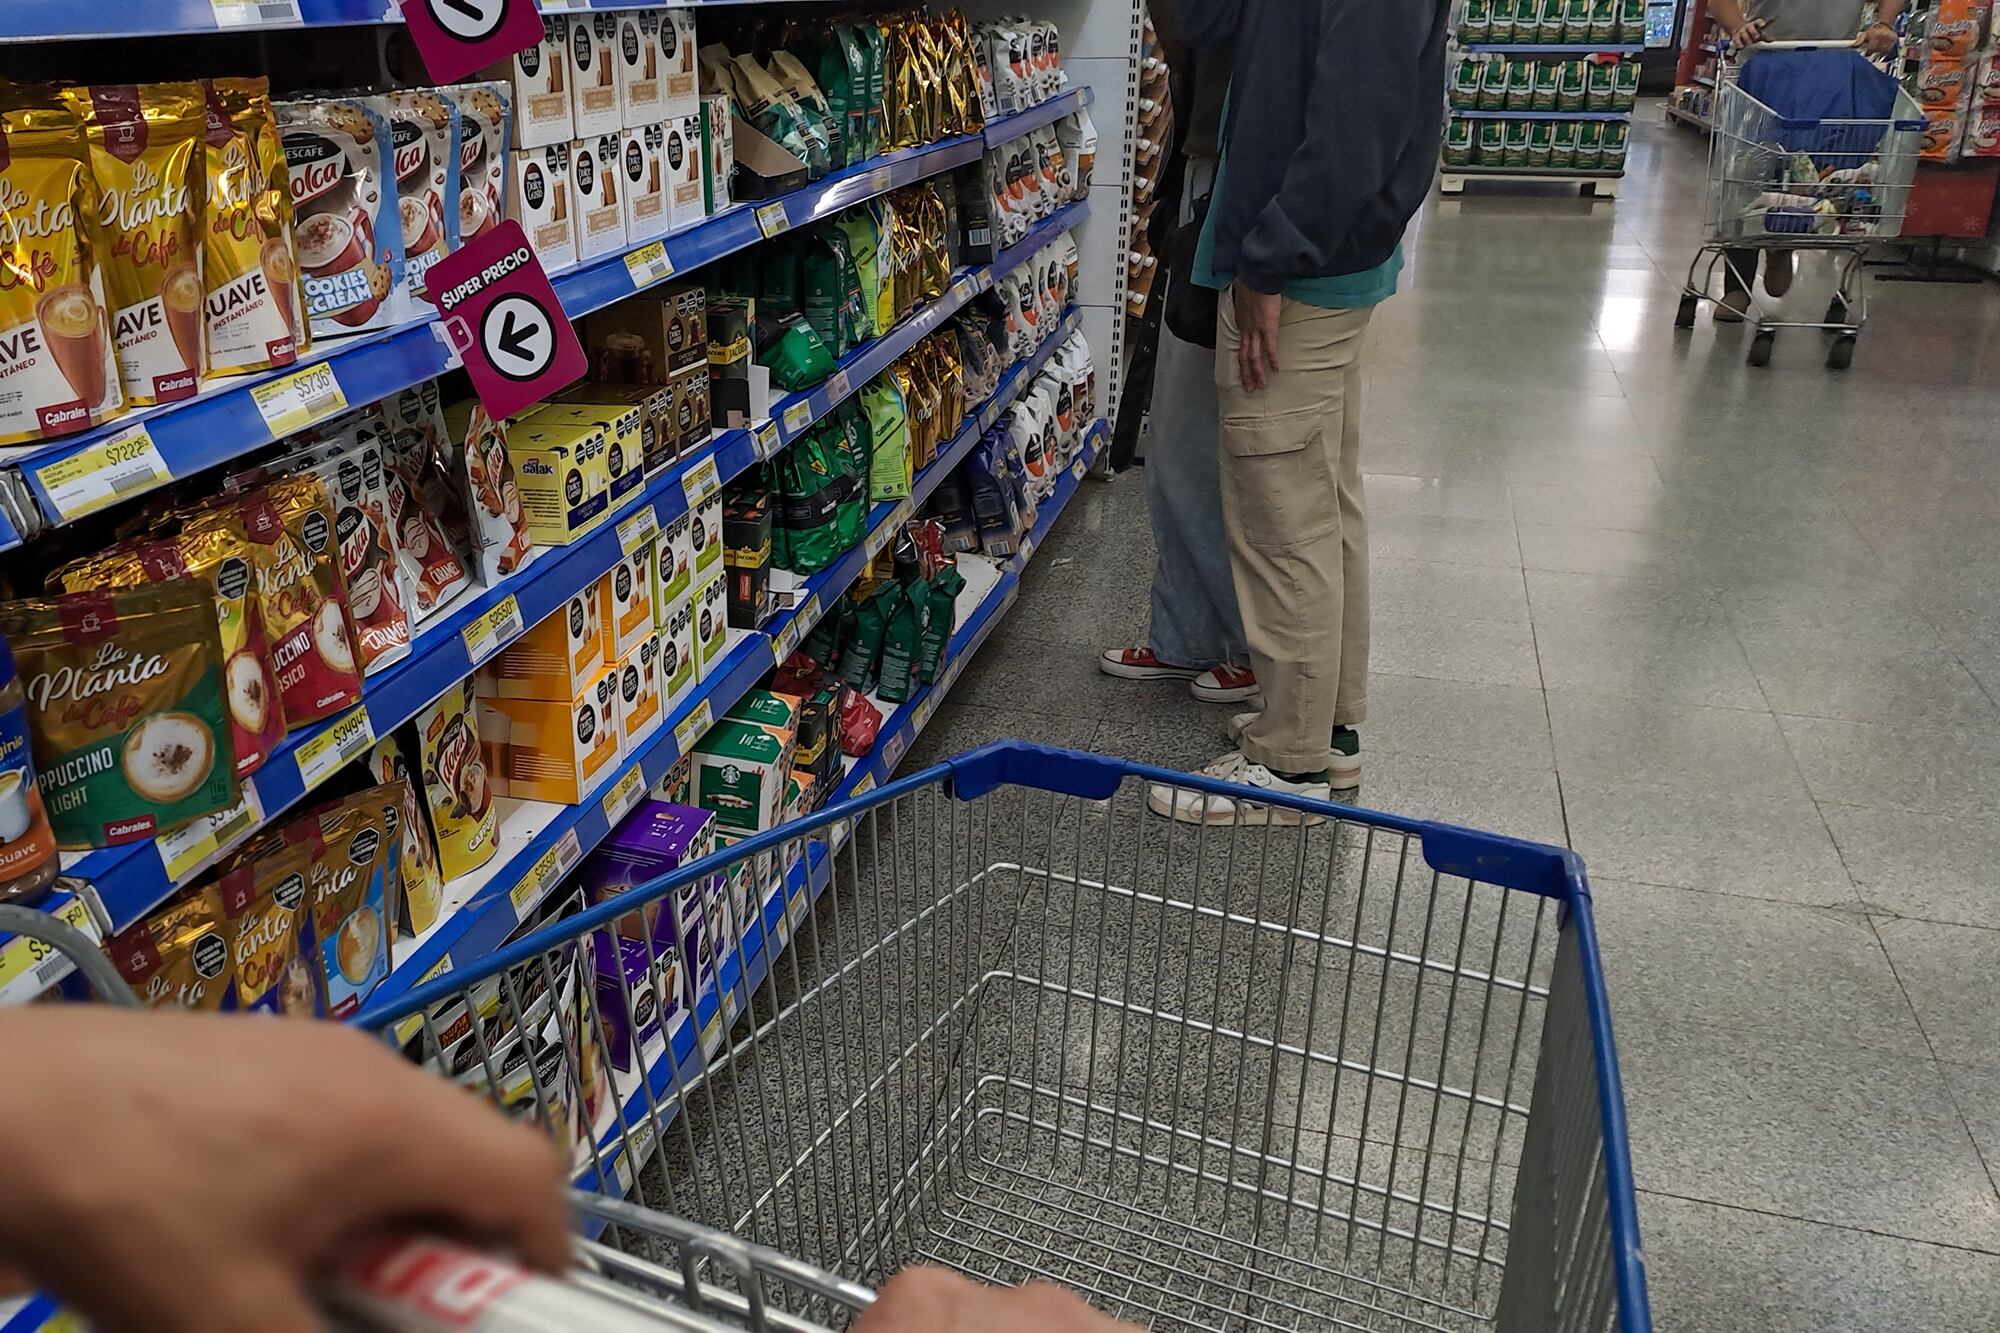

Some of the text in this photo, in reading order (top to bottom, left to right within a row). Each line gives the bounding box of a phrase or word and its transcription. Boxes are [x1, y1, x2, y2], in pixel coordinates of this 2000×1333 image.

[393, 131, 412, 142] CAFE
[285, 147, 324, 159] ESCAFE
[395, 147, 420, 176] lca
[461, 142, 478, 165] lca
[131, 160, 160, 198] La
[291, 162, 337, 197] olca
[0, 199, 75, 247] anta
[405, 249, 441, 275] OKIES
[304, 269, 368, 296] OOKIES
[440, 279, 484, 312] SUPER
[481, 247, 531, 288] PRECIO
[115, 302, 162, 339] AVE
[118, 330, 158, 350] ANTÁNEO
[159, 376, 194, 392] Cabrales
[45, 407, 87, 425] Cabrales
[89, 642, 128, 671] La
[28, 652, 168, 713] Planta
[38, 747, 114, 795] PPUCCINO
[51, 785, 88, 815] LIGHT
[109, 819, 153, 836] Cabrales
[315, 866, 358, 904] nta
[236, 912, 291, 965] anta
